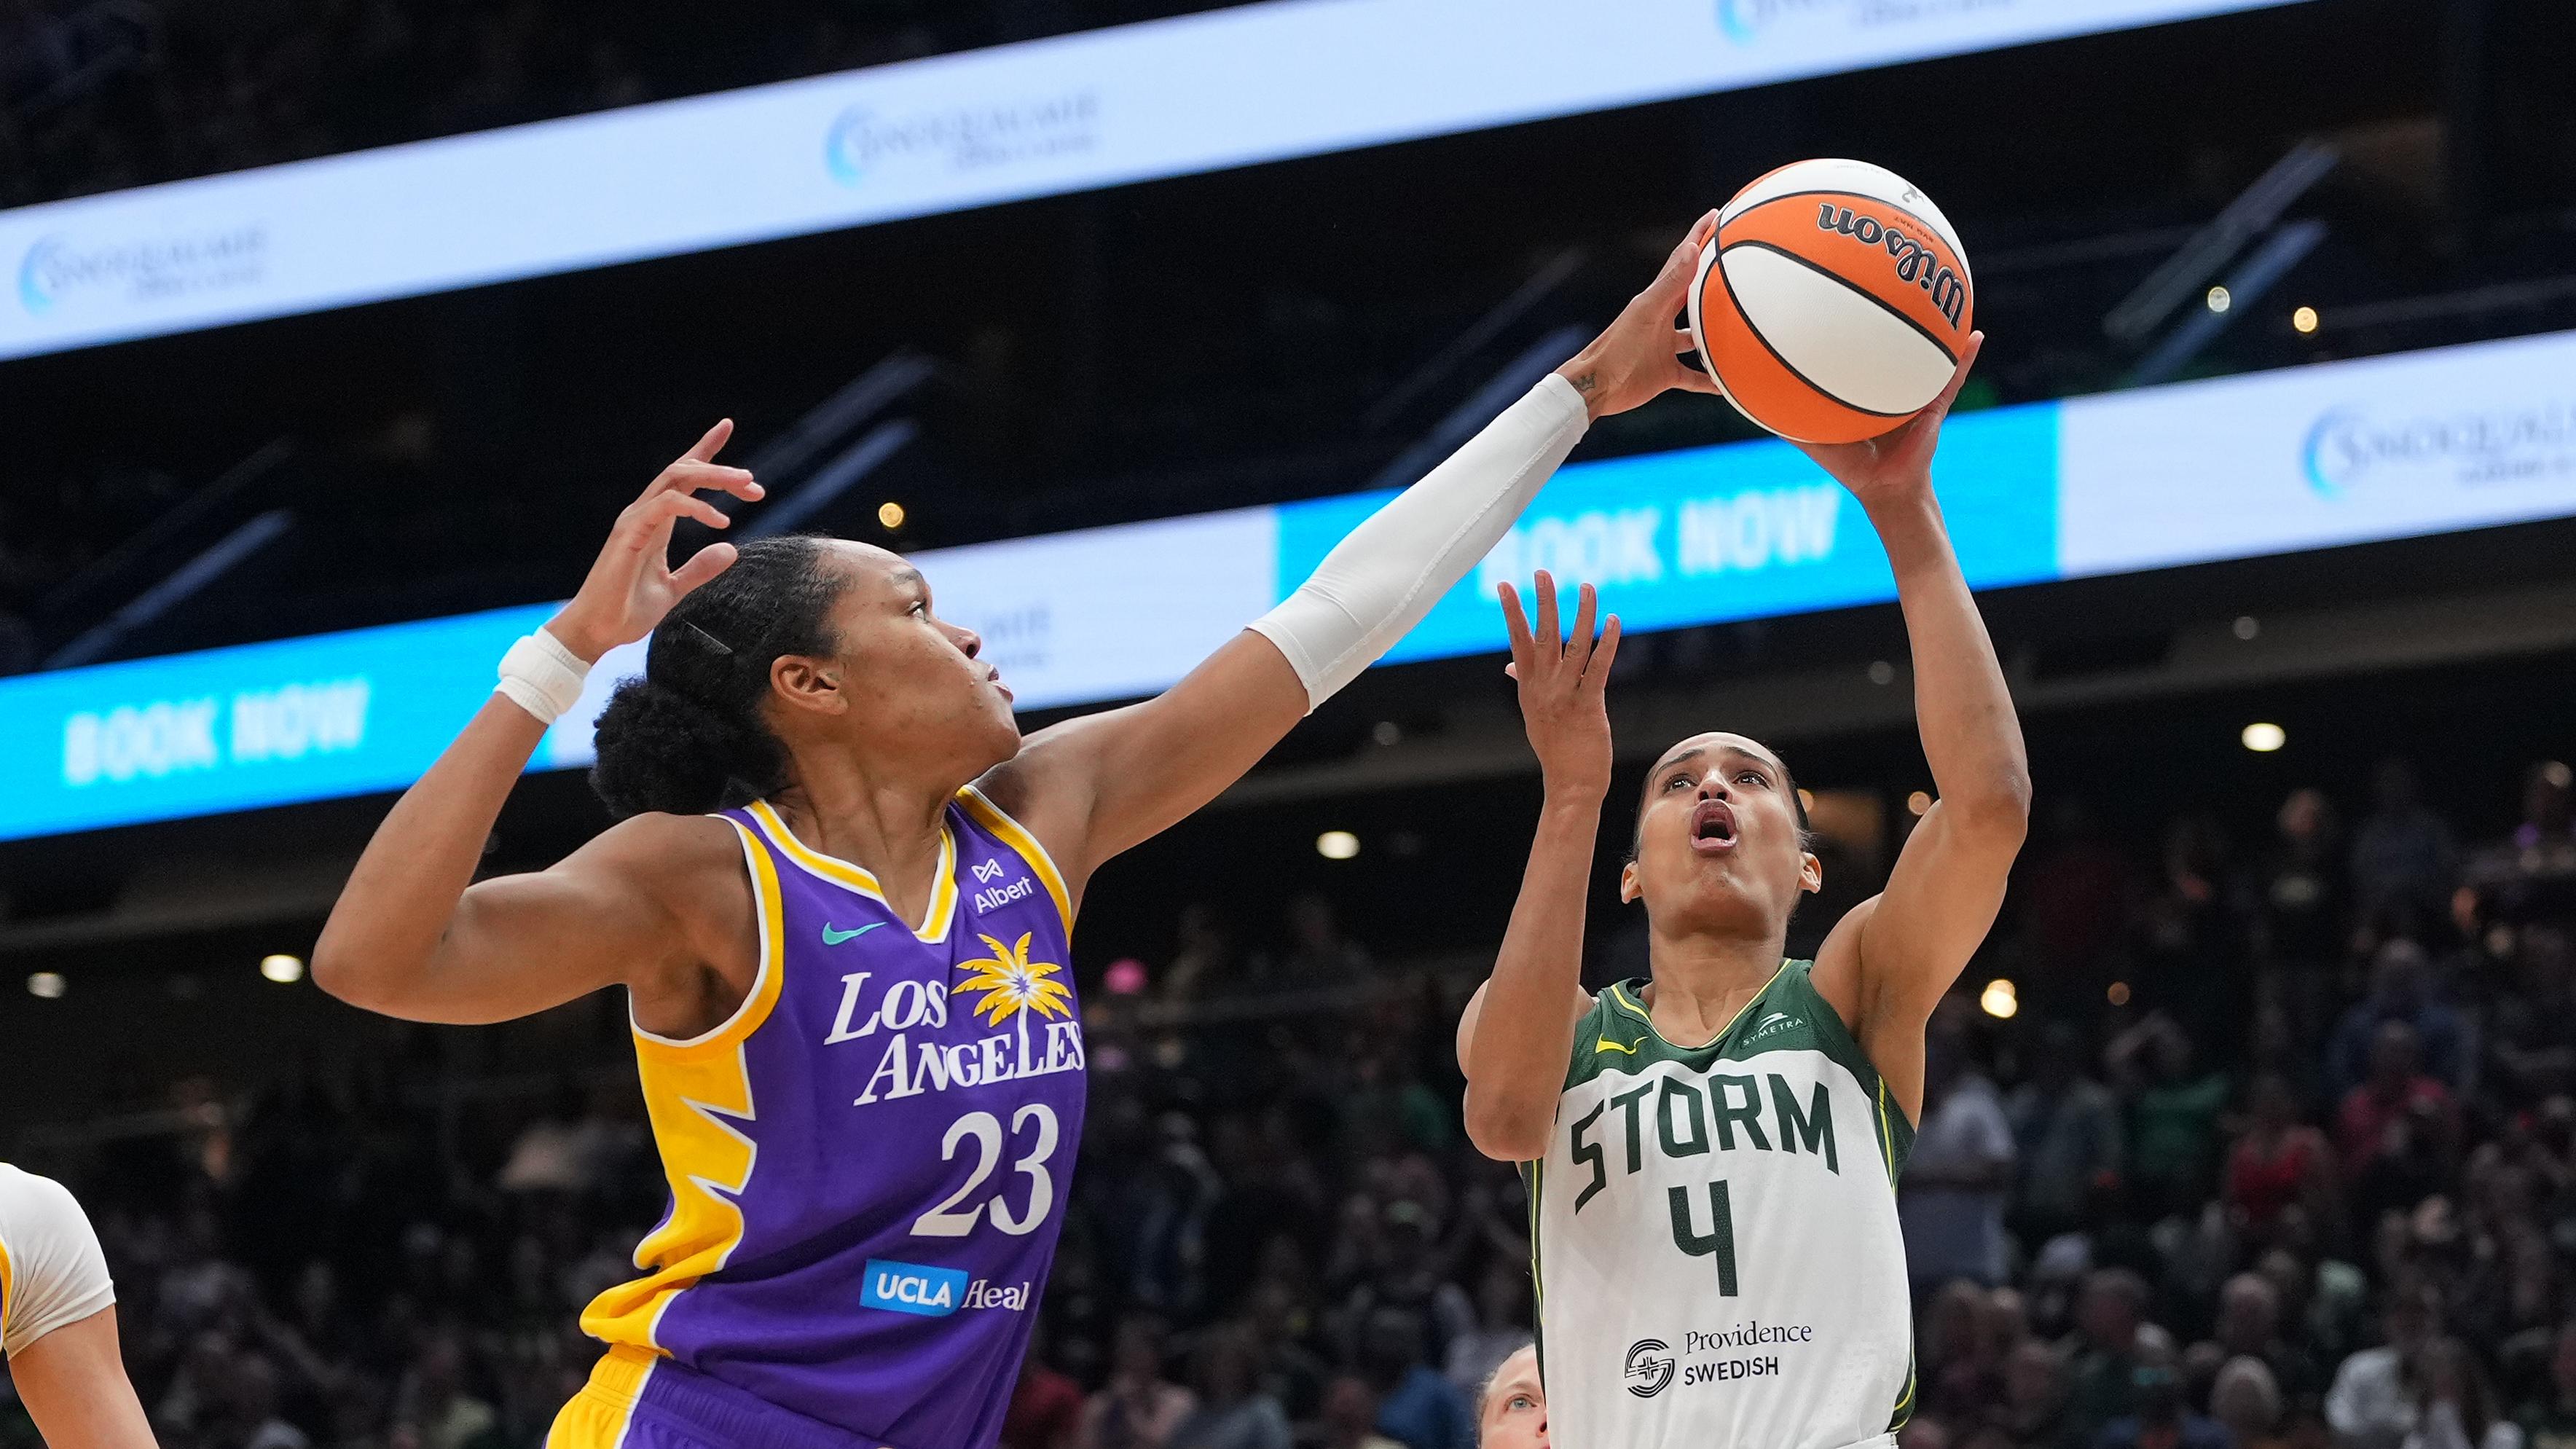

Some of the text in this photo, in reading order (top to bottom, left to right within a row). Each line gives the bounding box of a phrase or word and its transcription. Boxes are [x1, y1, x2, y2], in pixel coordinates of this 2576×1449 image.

[1817, 203, 1966, 331] Wilson
[1479, 484, 1841, 599] BOOK NOW
[66, 678, 370, 785] BOOK NOW
[974, 876, 1034, 914] Albert
[823, 972, 947, 1045] LOS
[1743, 1018, 1804, 1045] SYMETRA
[853, 1021, 1084, 1106] ANGELES
[909, 1103, 1059, 1236] 23
[1571, 1073, 1839, 1216] STORM
[1668, 1179, 1738, 1297] 4
[876, 1273, 951, 1308] UCLA
[1684, 1356, 1779, 1386] SWEDISH
[1685, 1321, 1812, 1355] Providence
